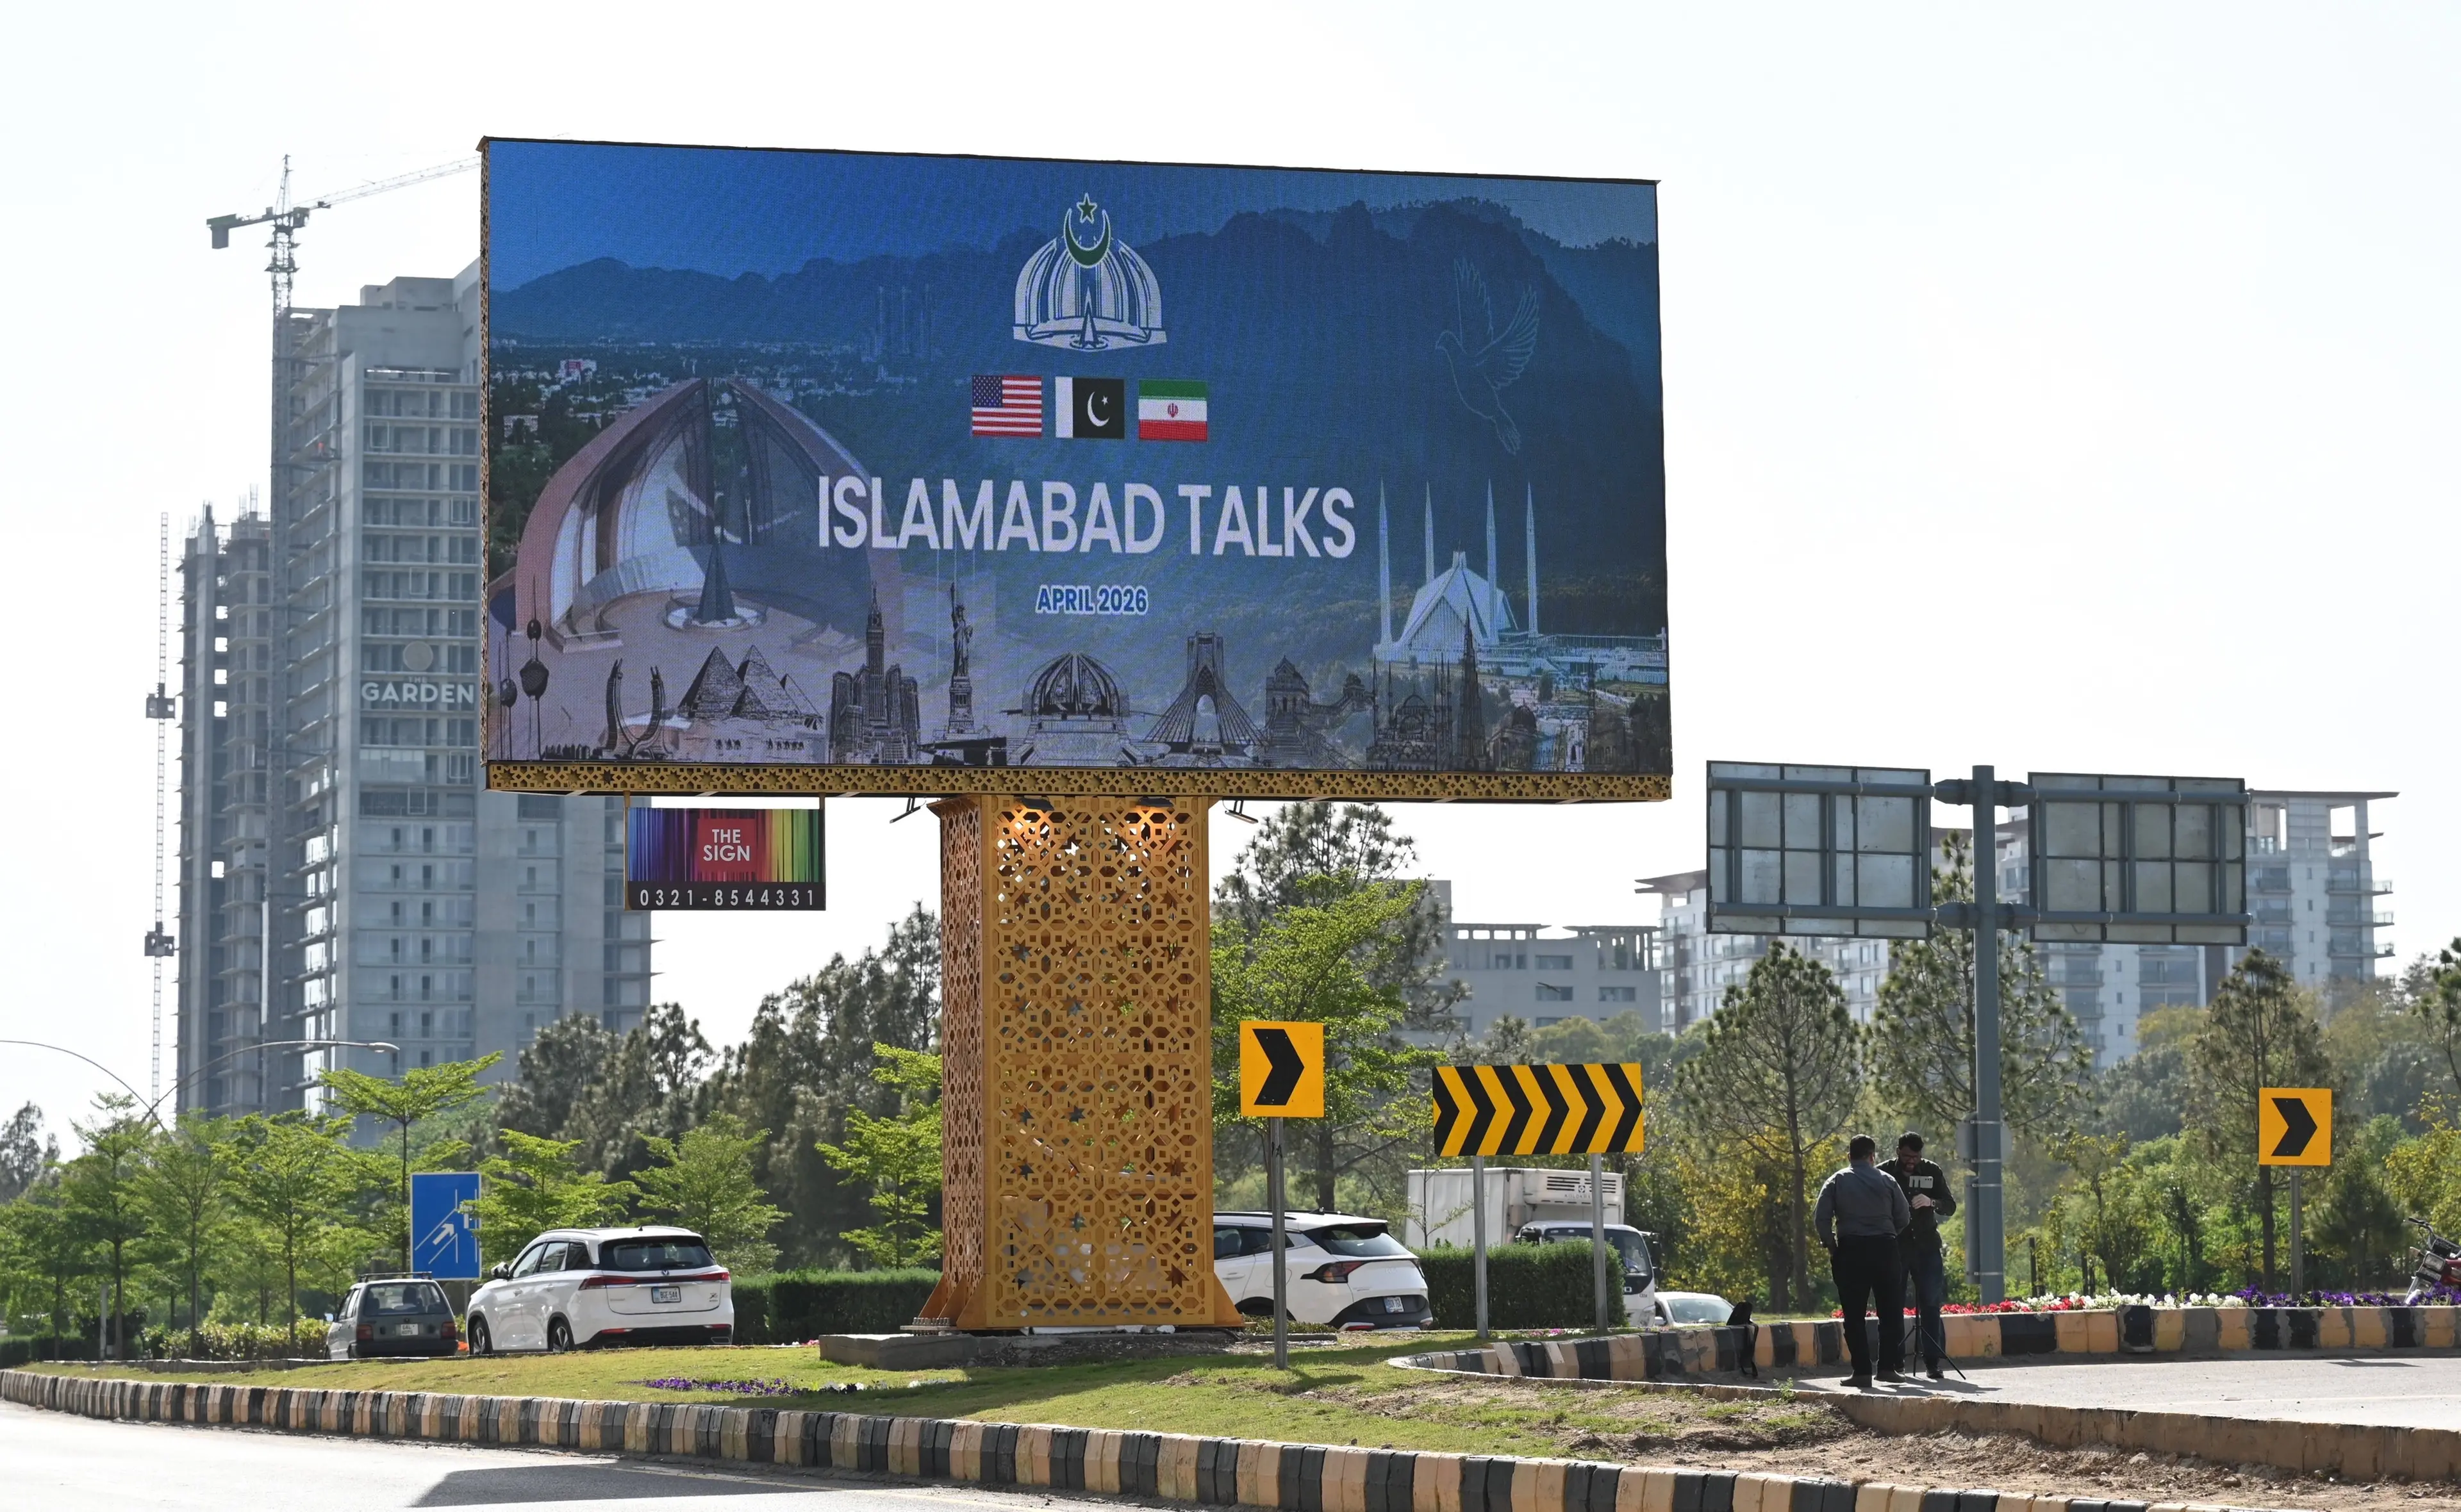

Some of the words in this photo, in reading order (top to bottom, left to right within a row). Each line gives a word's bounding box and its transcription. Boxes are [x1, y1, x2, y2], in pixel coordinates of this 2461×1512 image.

[818, 475, 1165, 554] ISLAMABAD
[1178, 484, 1355, 559] TALKS
[1036, 587, 1095, 613] APRIL
[1098, 586, 1148, 614] 2026
[361, 682, 474, 703] GARDEN
[711, 829, 741, 844] THE
[703, 845, 750, 862] SIGN
[640, 889, 813, 906] 0321-8544331
